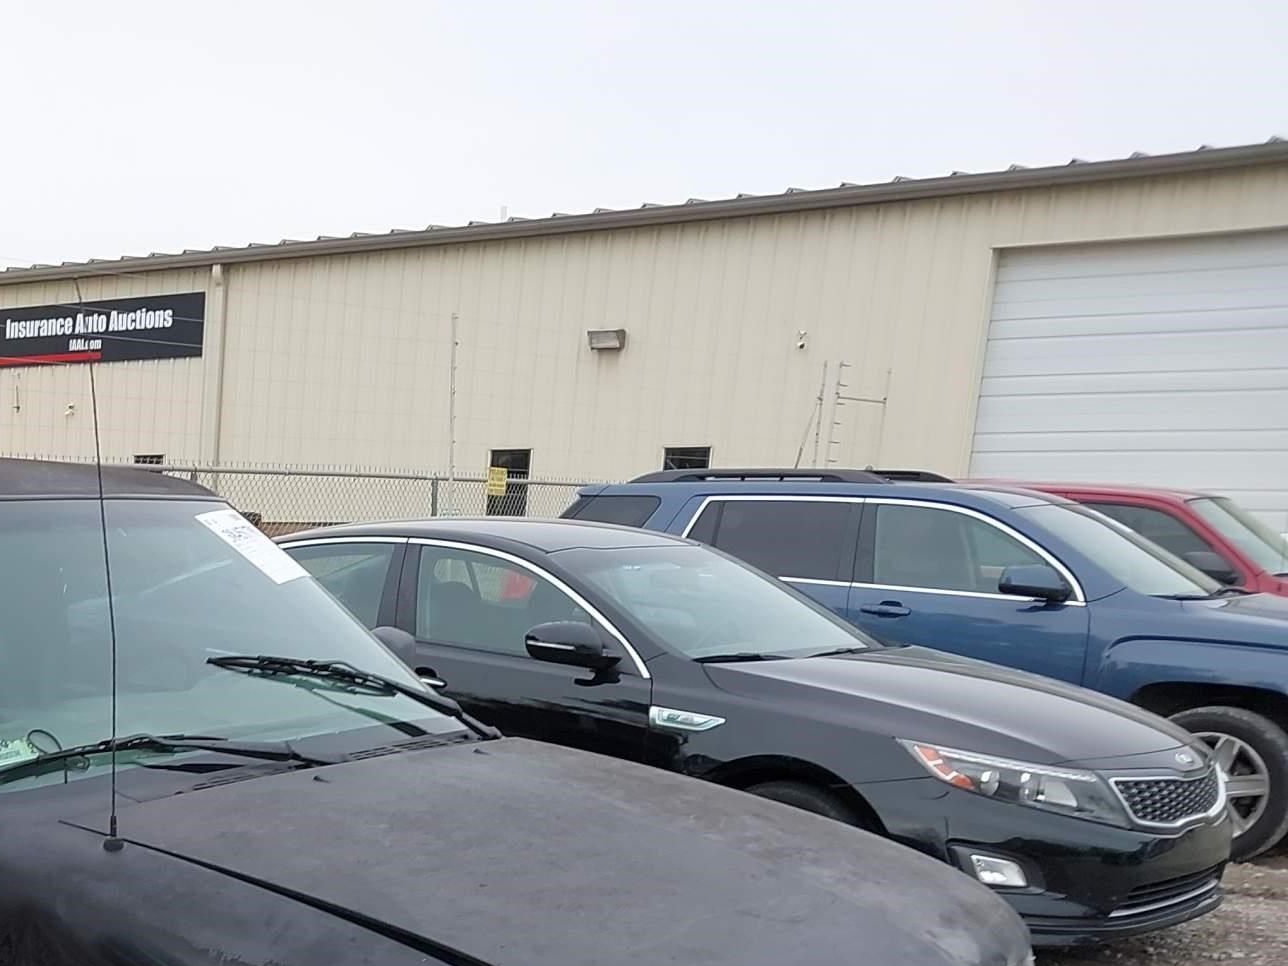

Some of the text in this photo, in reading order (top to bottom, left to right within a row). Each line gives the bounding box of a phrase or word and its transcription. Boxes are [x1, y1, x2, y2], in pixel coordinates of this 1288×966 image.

[5, 308, 173, 340] Insurance Auto Auctions
